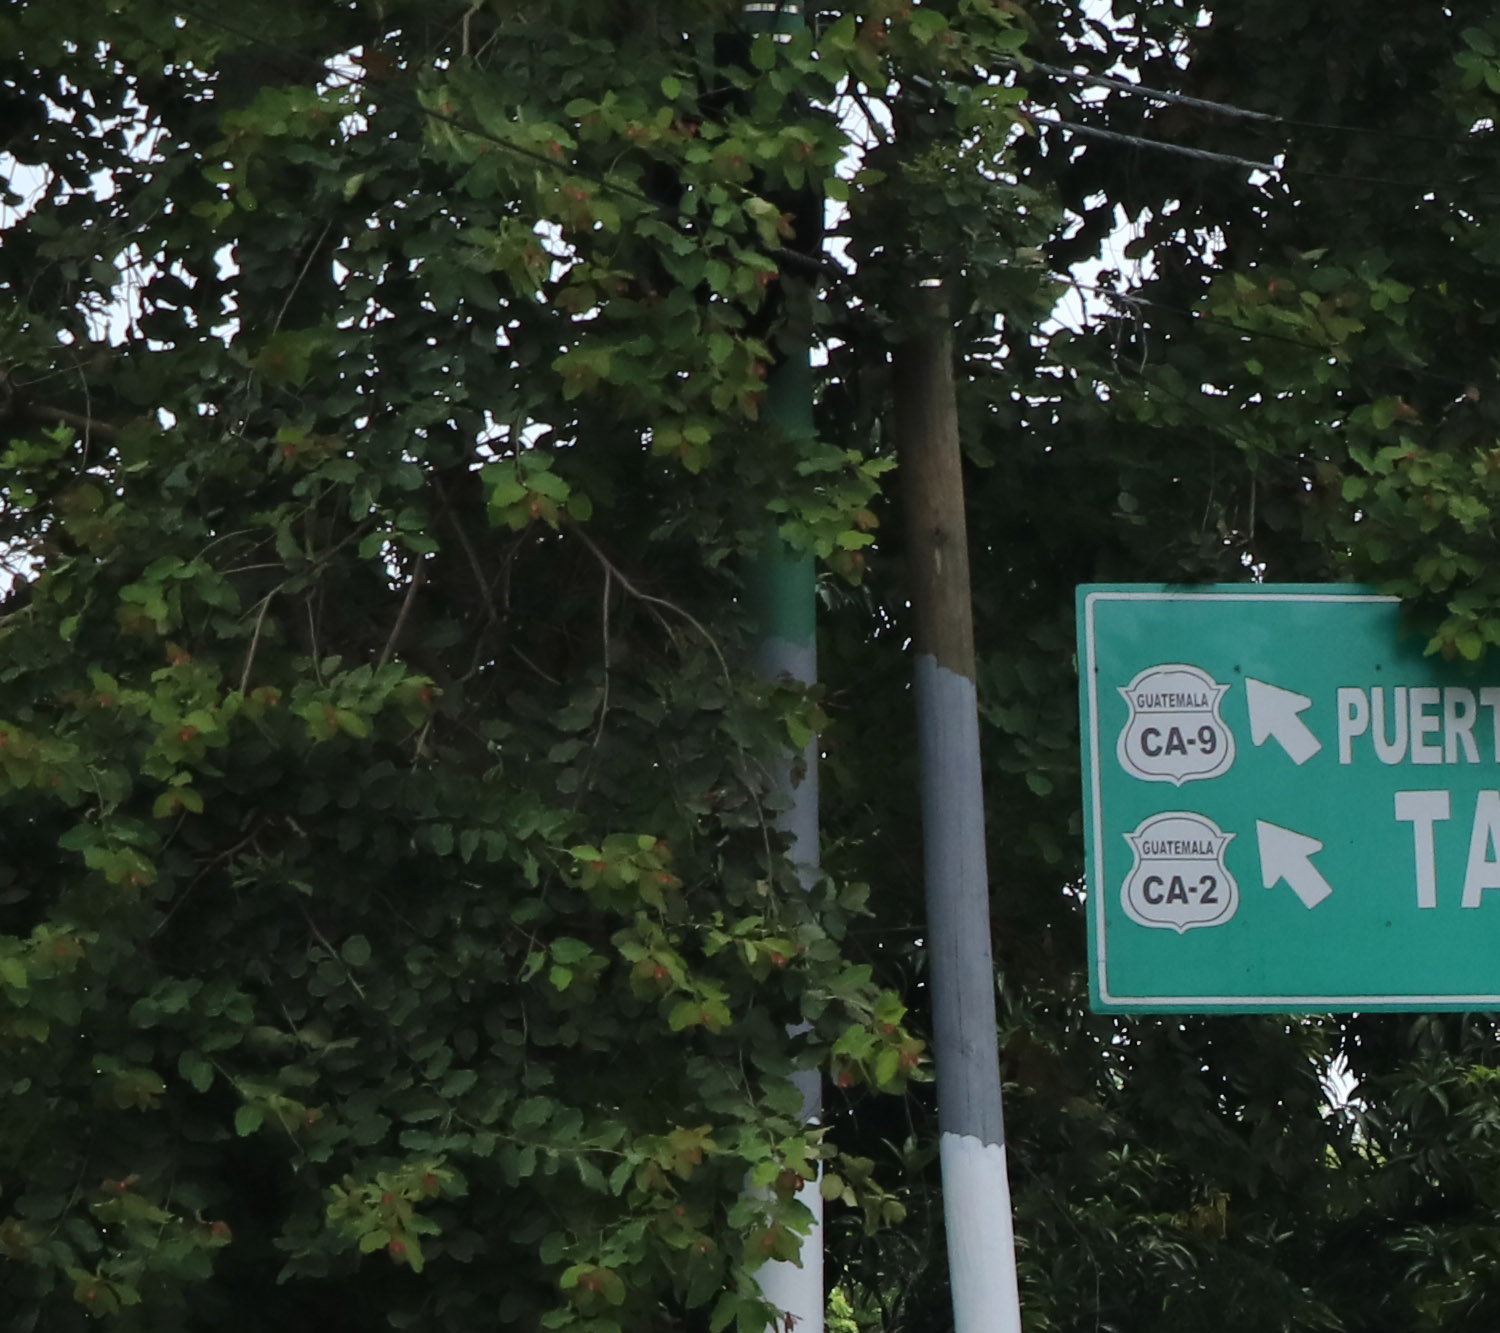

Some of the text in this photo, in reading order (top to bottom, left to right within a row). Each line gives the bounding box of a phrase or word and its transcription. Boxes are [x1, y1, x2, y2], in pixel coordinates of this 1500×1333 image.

[1136, 692, 1210, 711] GUATEMALA
[1139, 726, 1218, 758] CA-9
[1142, 839, 1215, 857] GUATEMALA
[1142, 875, 1220, 907] CA-2
